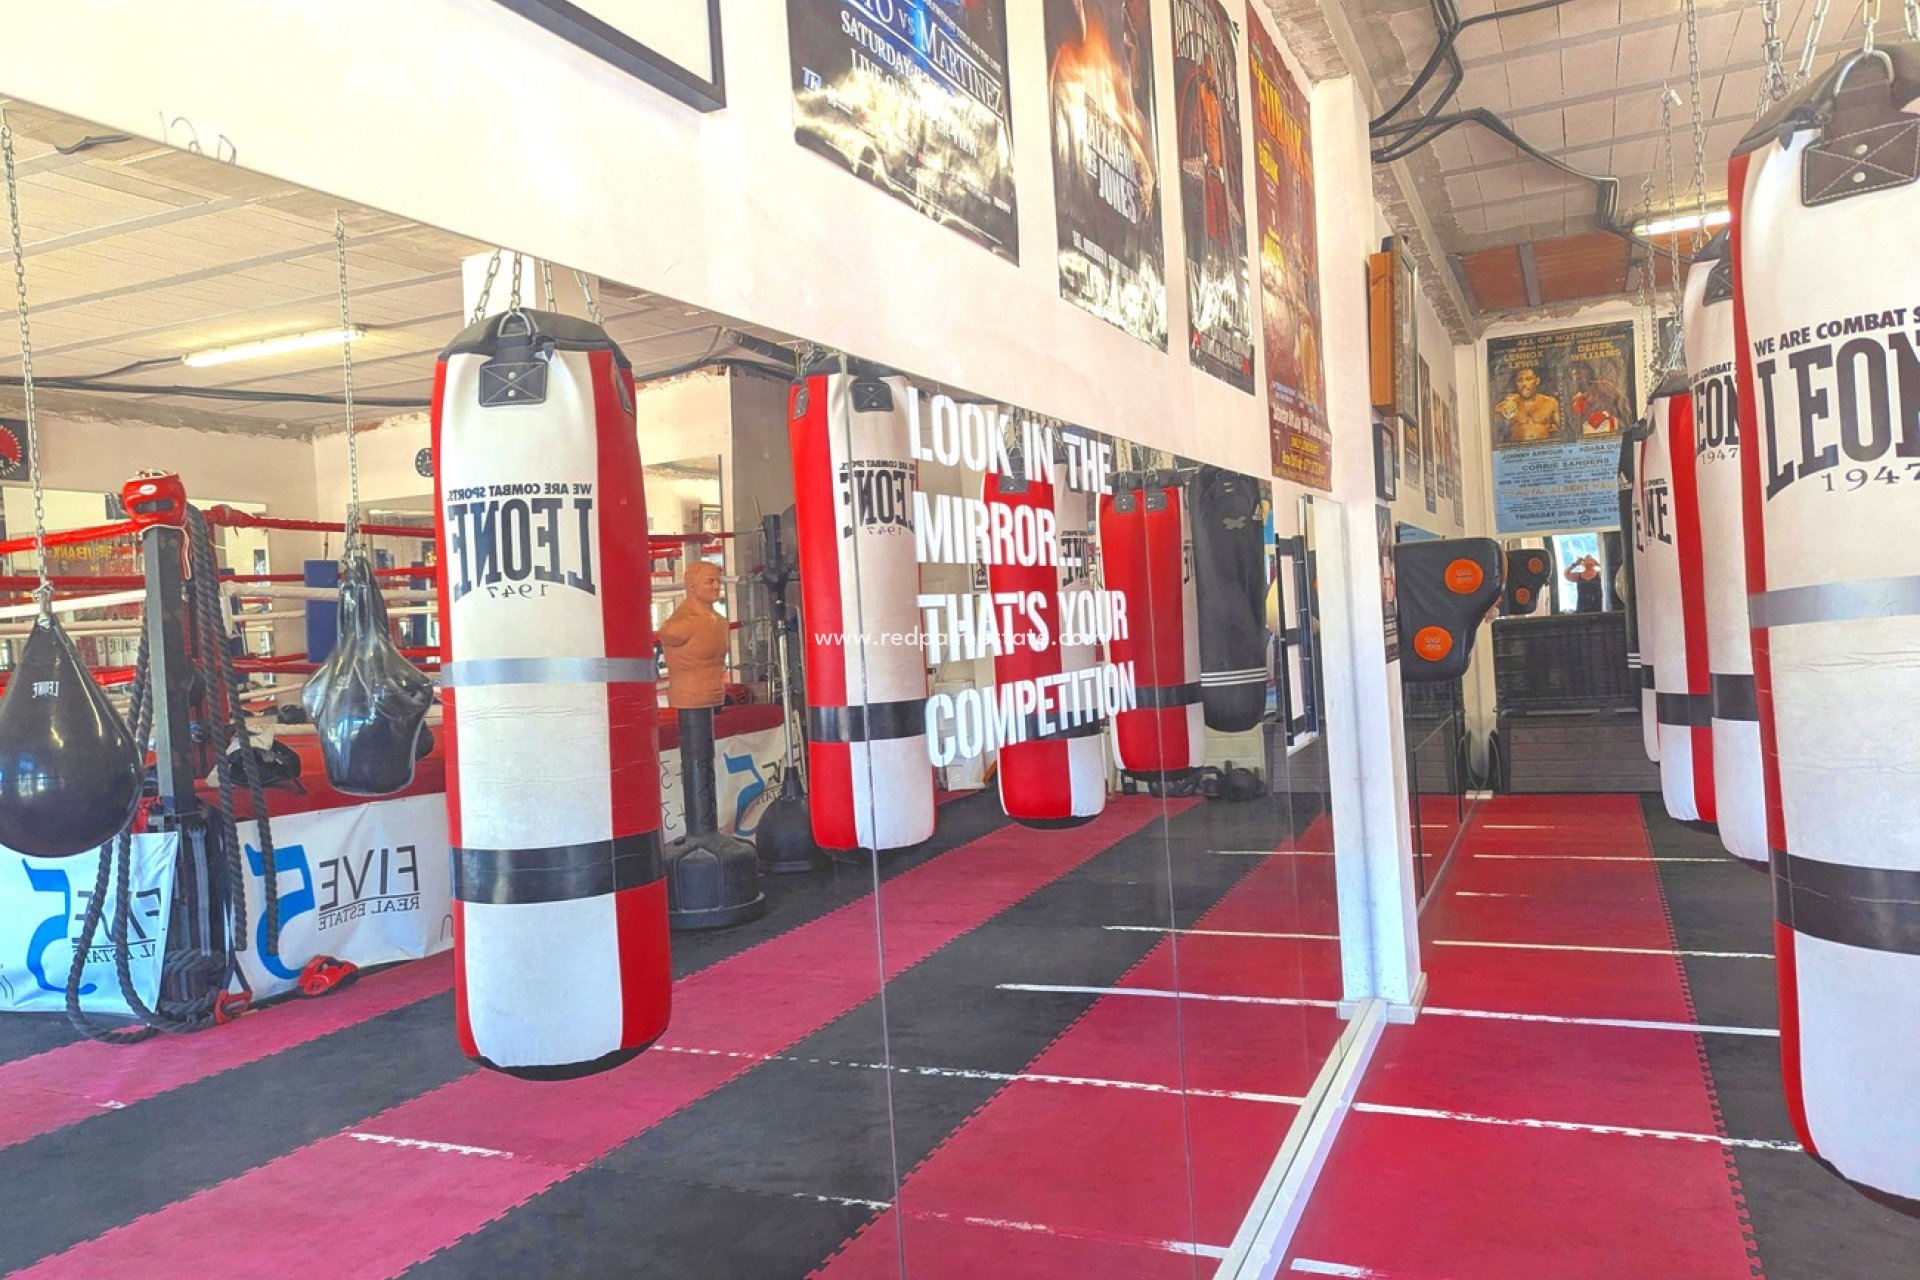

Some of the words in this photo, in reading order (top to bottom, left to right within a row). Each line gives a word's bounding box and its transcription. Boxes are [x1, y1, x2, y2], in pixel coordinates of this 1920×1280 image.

[841, 10, 913, 77] SATURDAY
[1098, 157, 1137, 225] JONES
[1754, 337, 1775, 357] WE
[1779, 327, 1811, 350] ARE
[1815, 308, 1907, 340] COMBAT
[1700, 362, 1733, 381] COMBAT
[906, 385, 1014, 478] LOOK
[1022, 421, 1055, 482] IN
[1062, 432, 1113, 495] THE
[1702, 447, 1740, 465] 1947
[1515, 512, 1556, 521] THURSDAY
[1577, 508, 1600, 516] APRIL
[916, 590, 1050, 665] THAT'S
[1056, 589, 1130, 647] YOUR
[925, 660, 1137, 769] COMPETITION
